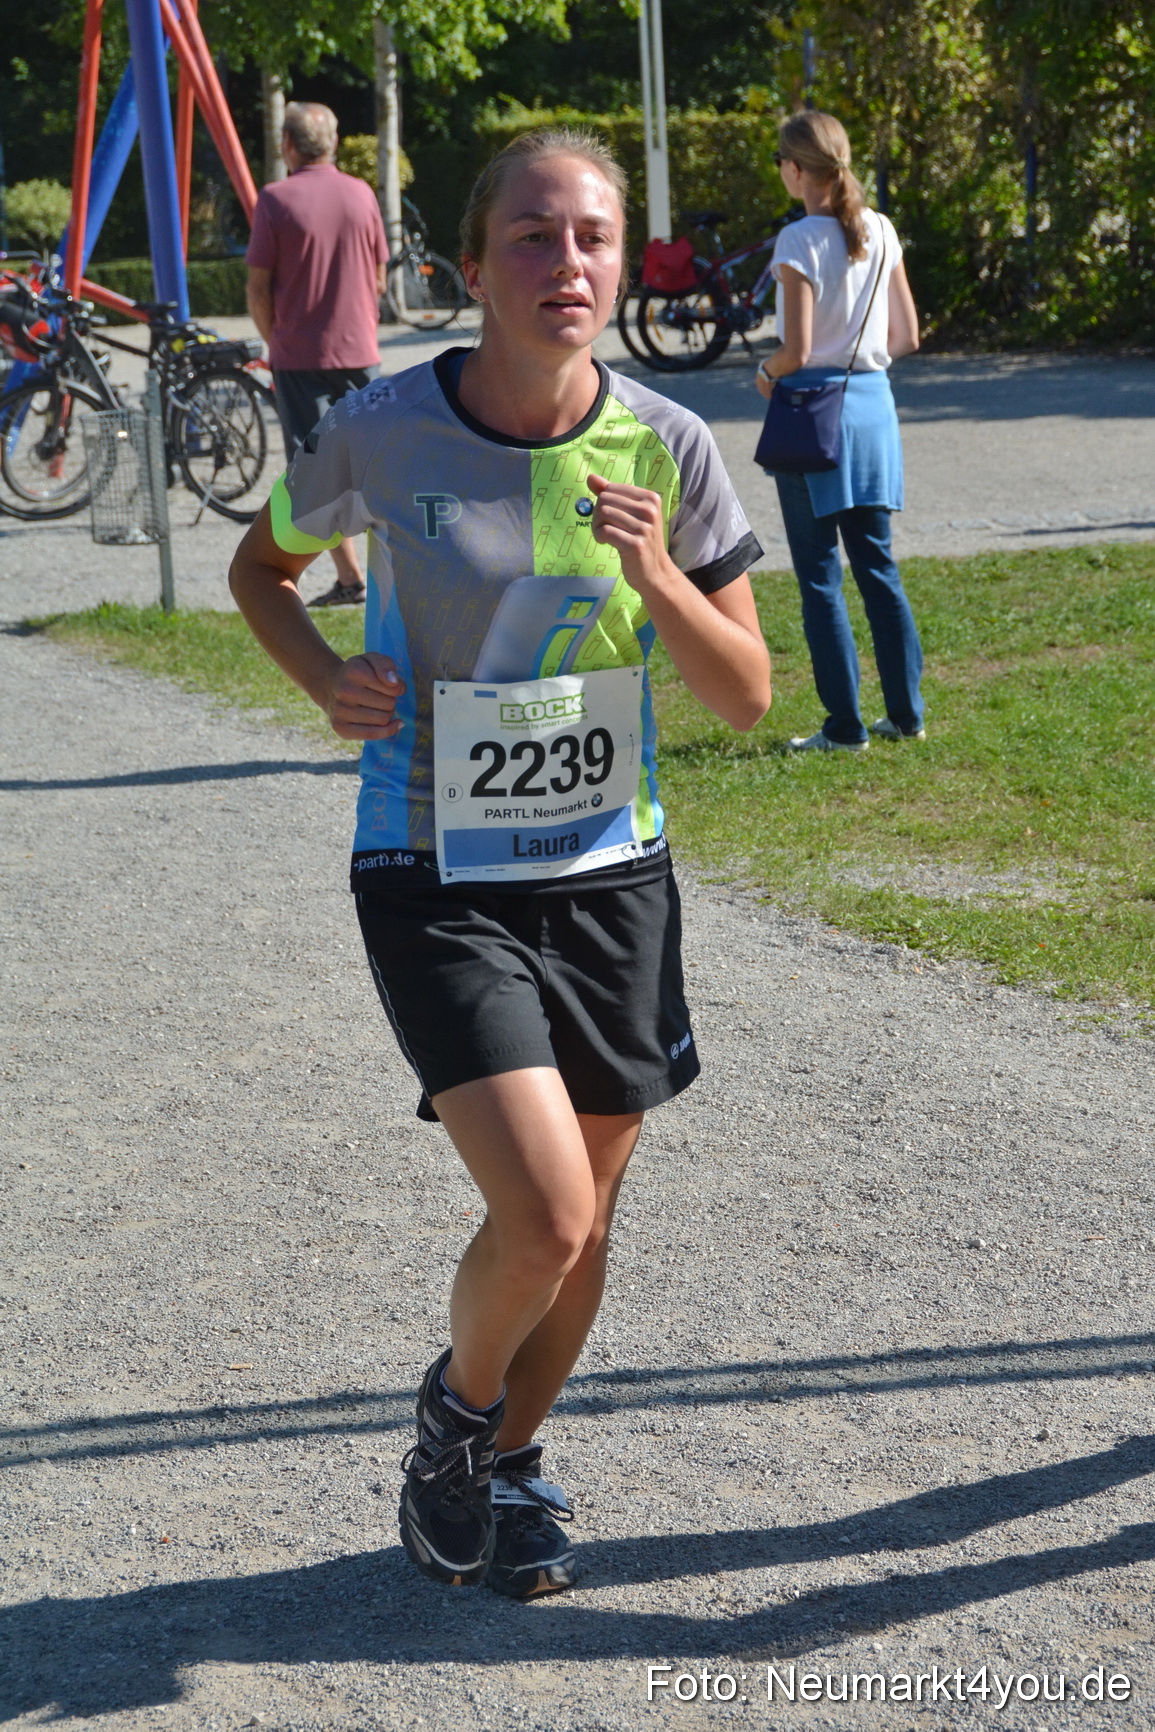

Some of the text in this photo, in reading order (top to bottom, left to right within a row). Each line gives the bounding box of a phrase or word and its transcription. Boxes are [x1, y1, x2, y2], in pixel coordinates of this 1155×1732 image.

[575, 520, 593, 528] PART
[500, 692, 587, 723] BOCK
[541, 719, 561, 728] smart
[469, 727, 615, 798] 2239
[448, 787, 456, 799] D
[484, 799, 588, 819] PARTL Neumarkt
[513, 831, 580, 858] Laura
